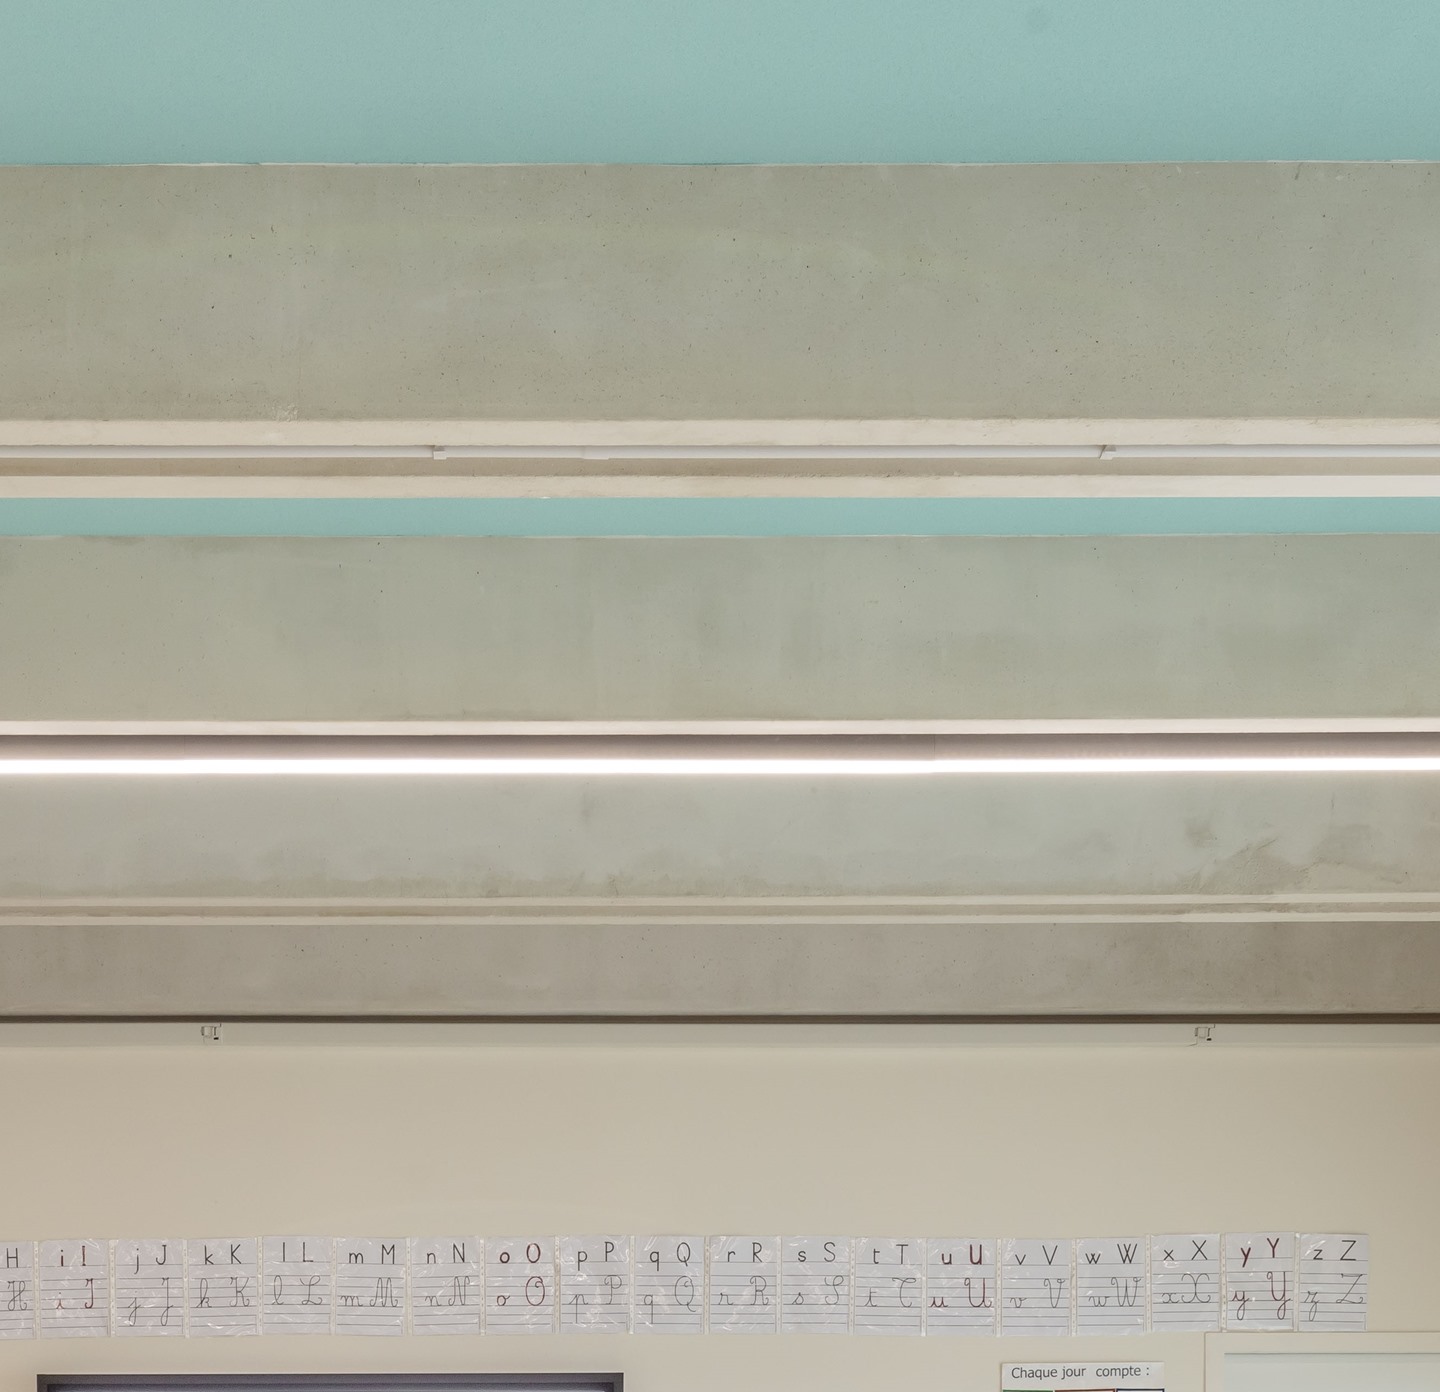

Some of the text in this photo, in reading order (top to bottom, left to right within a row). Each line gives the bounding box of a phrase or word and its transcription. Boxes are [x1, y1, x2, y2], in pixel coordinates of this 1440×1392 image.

[7, 1248, 18, 1268] H
[134, 1245, 168, 1274] j J
[204, 1244, 241, 1265] k K
[303, 1242, 314, 1262] L
[349, 1244, 395, 1264] m M
[427, 1243, 465, 1264] n N
[500, 1243, 541, 1264] o O
[578, 1241, 614, 1271] p P
[650, 1242, 690, 1271] q Q
[728, 1242, 763, 1263] r R
[798, 1242, 835, 1262] s S
[873, 1244, 908, 1265] t T
[942, 1244, 982, 1265] u U
[1015, 1245, 1058, 1265] v V
[1085, 1244, 1137, 1264] w W
[1163, 1240, 1208, 1261] x X
[1241, 1238, 1279, 1268] y Y
[1313, 1240, 1357, 1261] z Z
[1011, 1366, 1141, 1379] Chaque jour compte
